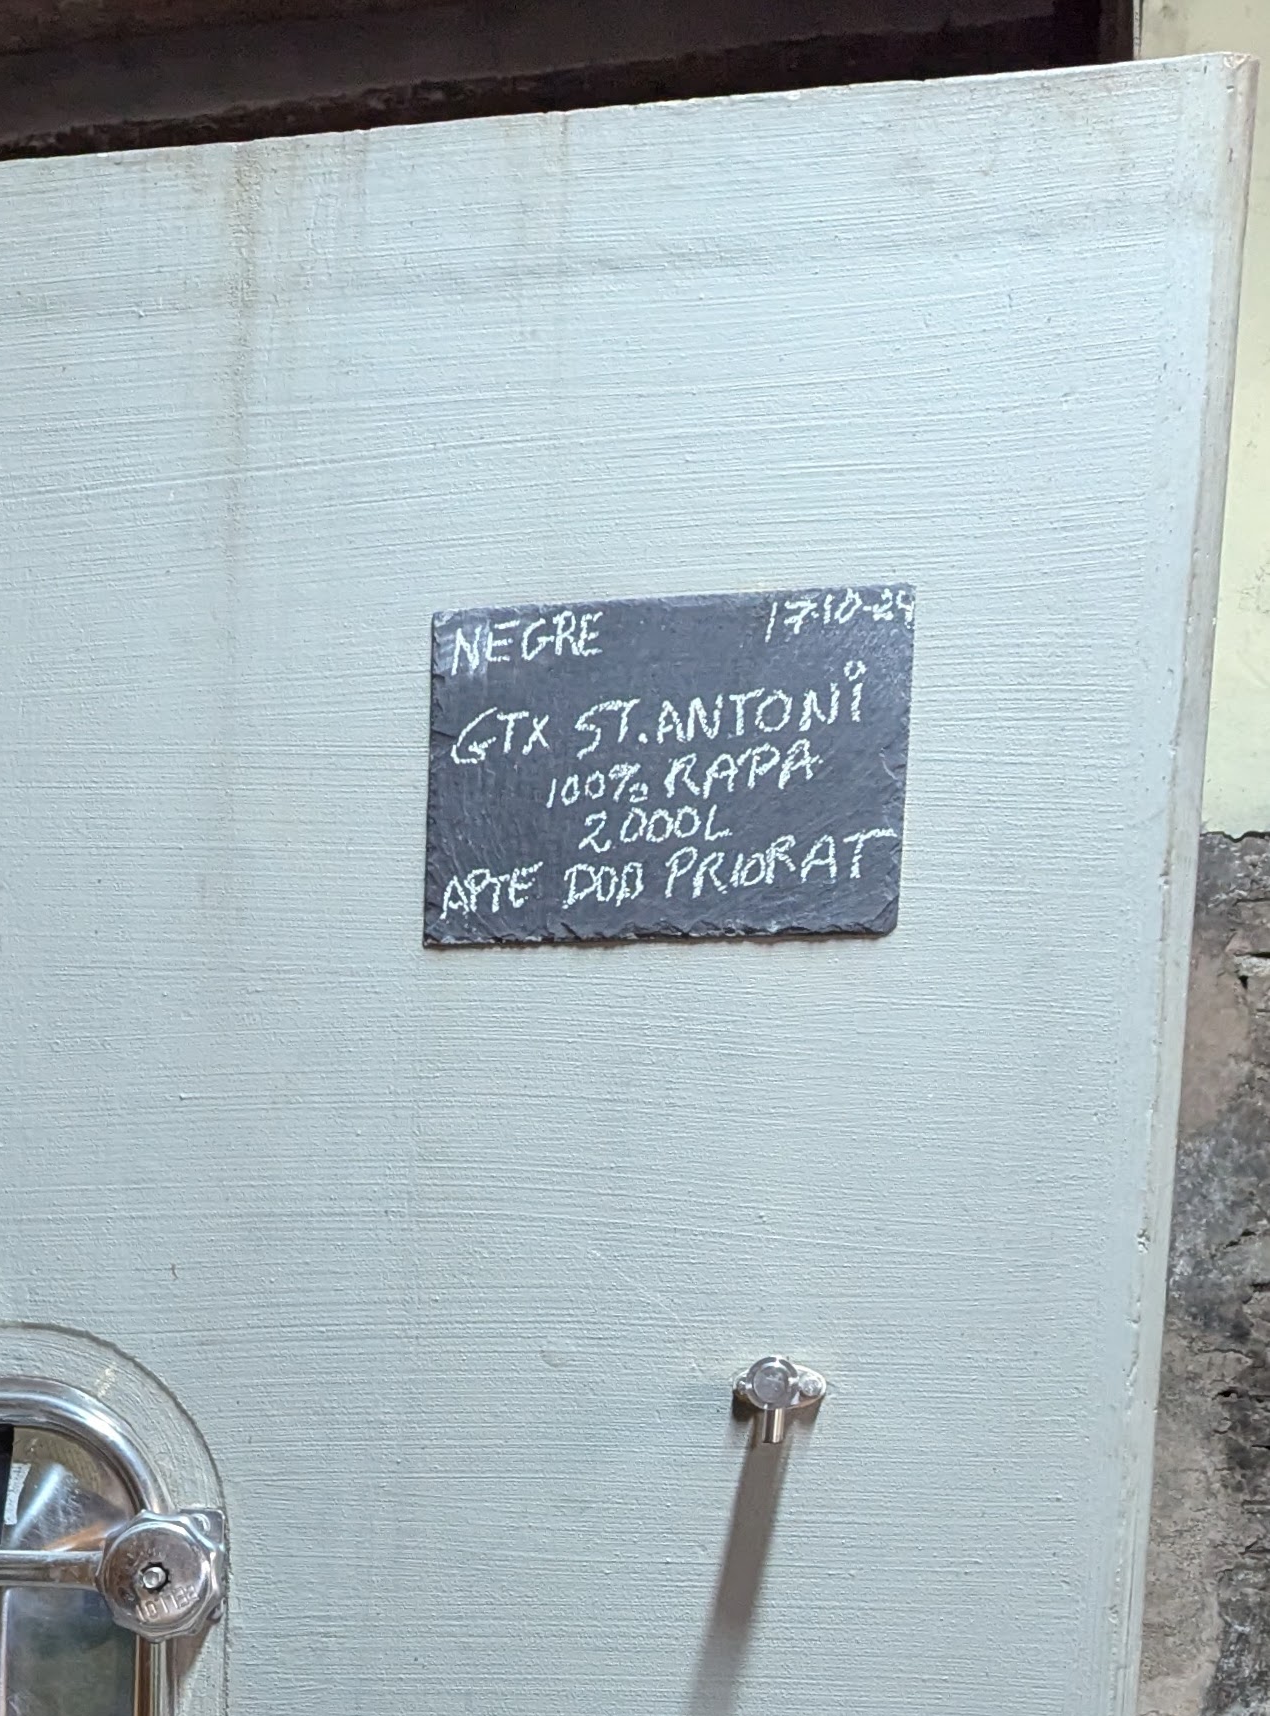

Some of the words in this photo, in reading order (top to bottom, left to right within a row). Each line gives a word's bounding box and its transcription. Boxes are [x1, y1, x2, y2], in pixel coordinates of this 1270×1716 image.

[451, 610, 603, 674] NEGRE
[546, 761, 649, 808] 100%
[665, 739, 823, 801] RAPA
[439, 861, 544, 920] APTE
[664, 828, 898, 899] PRIORAT
